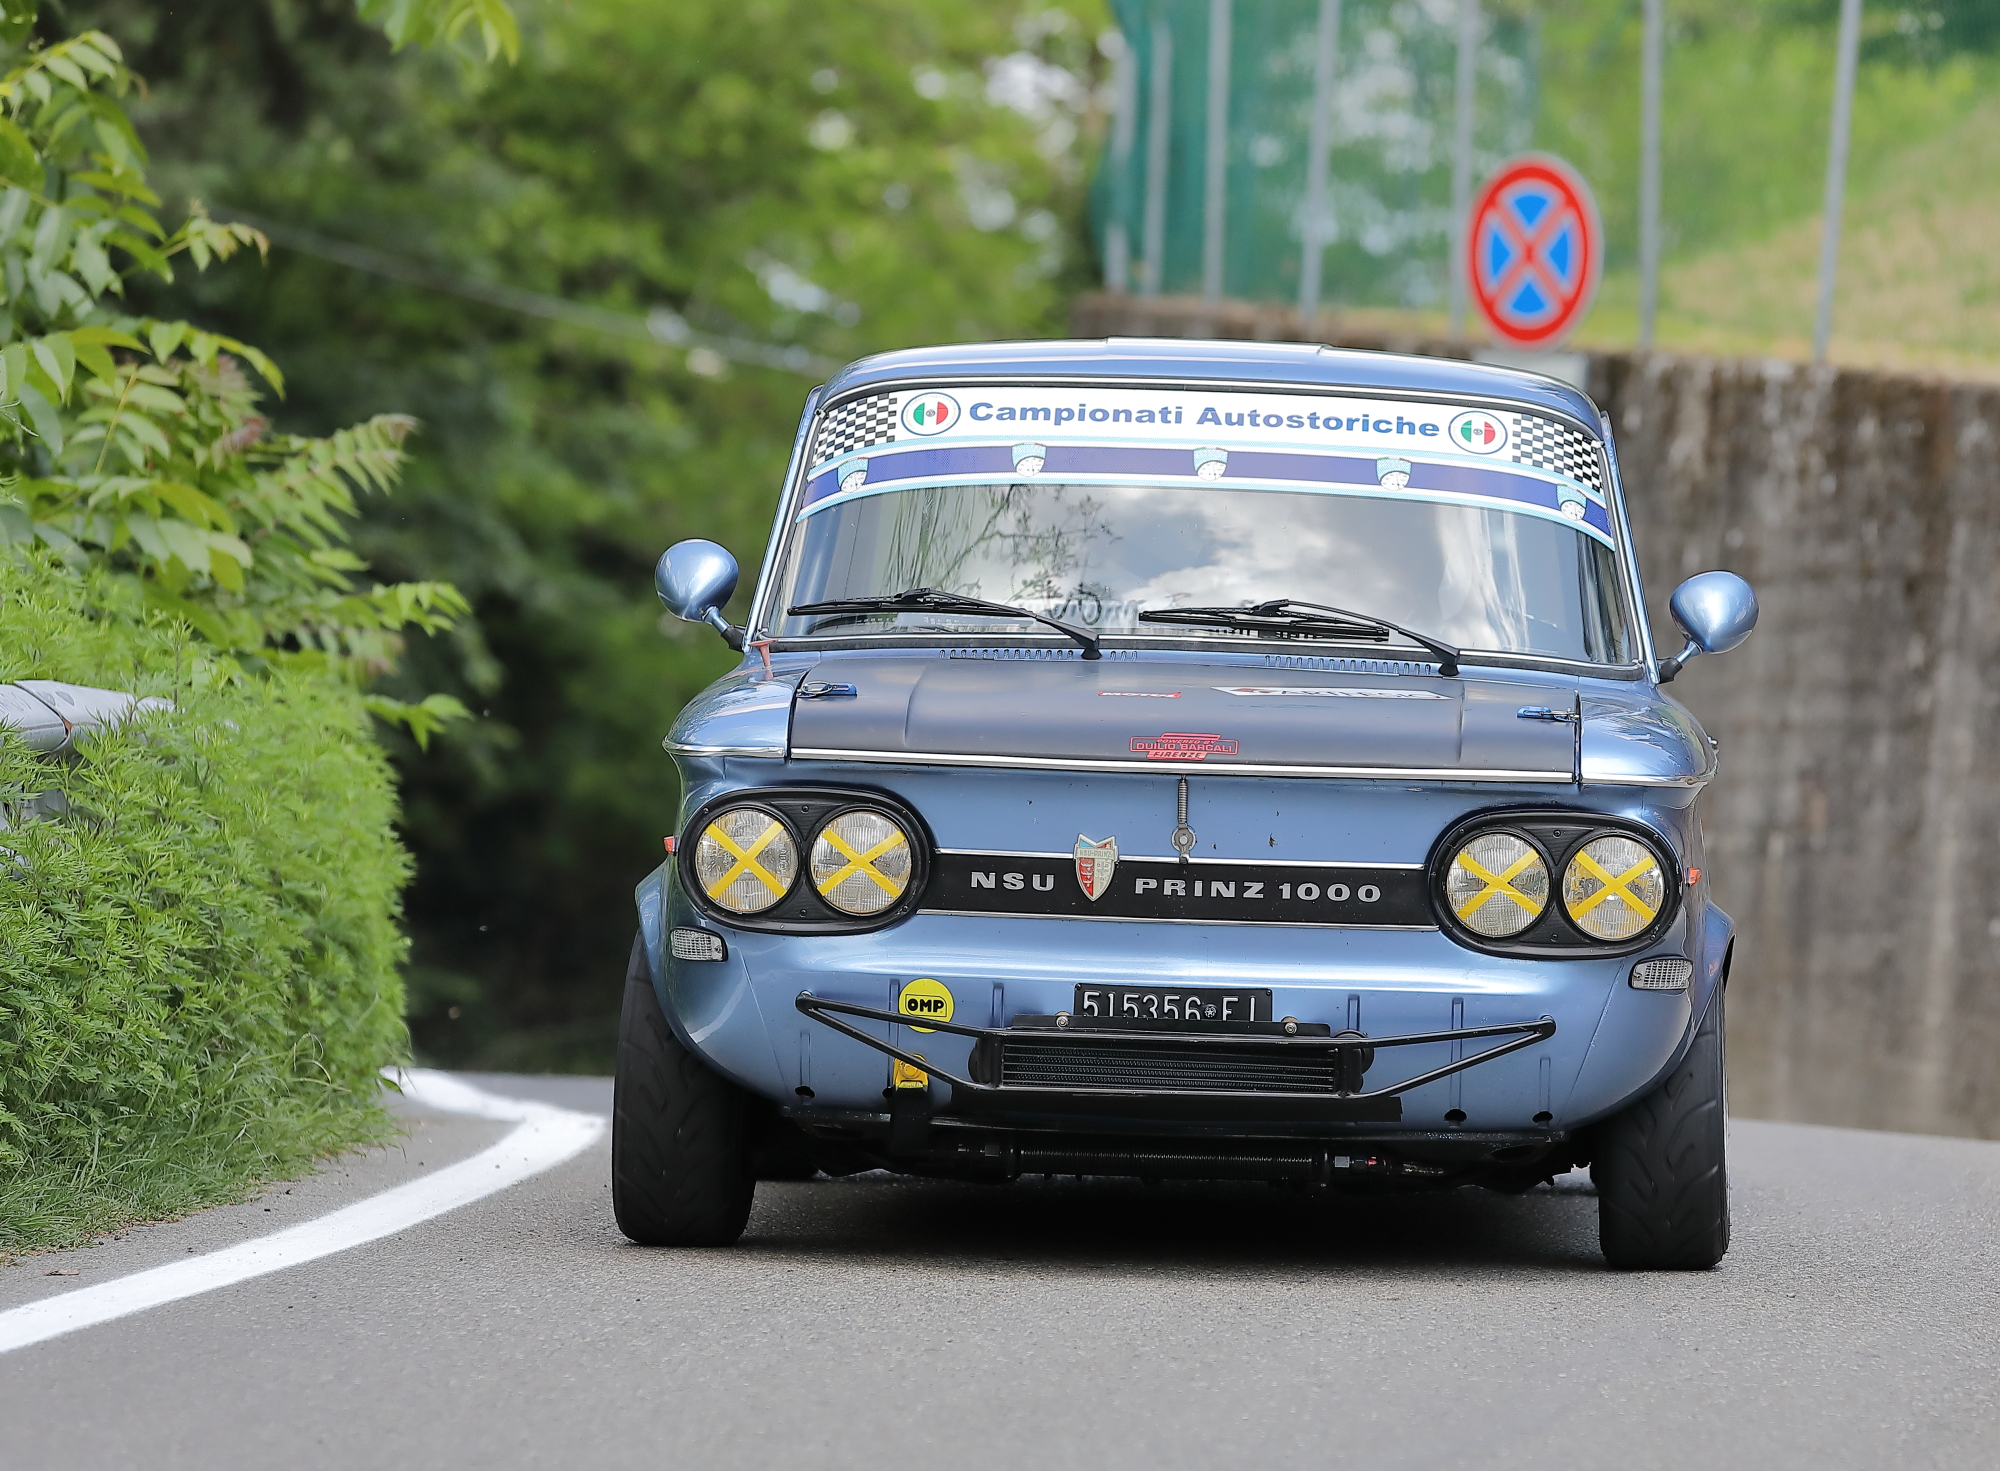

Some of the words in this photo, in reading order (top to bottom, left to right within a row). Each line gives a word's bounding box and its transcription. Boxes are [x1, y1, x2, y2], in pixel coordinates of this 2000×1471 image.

[969, 402, 1183, 426] Campionati
[1196, 407, 1440, 437] Autostoriche
[1180, 743, 1232, 752] BARCALI
[970, 871, 1055, 892] NSU
[1134, 878, 1265, 900] PRINZ
[1278, 883, 1382, 902] 1000
[907, 998, 944, 1013] OMP
[1083, 991, 1202, 1021] 515356
